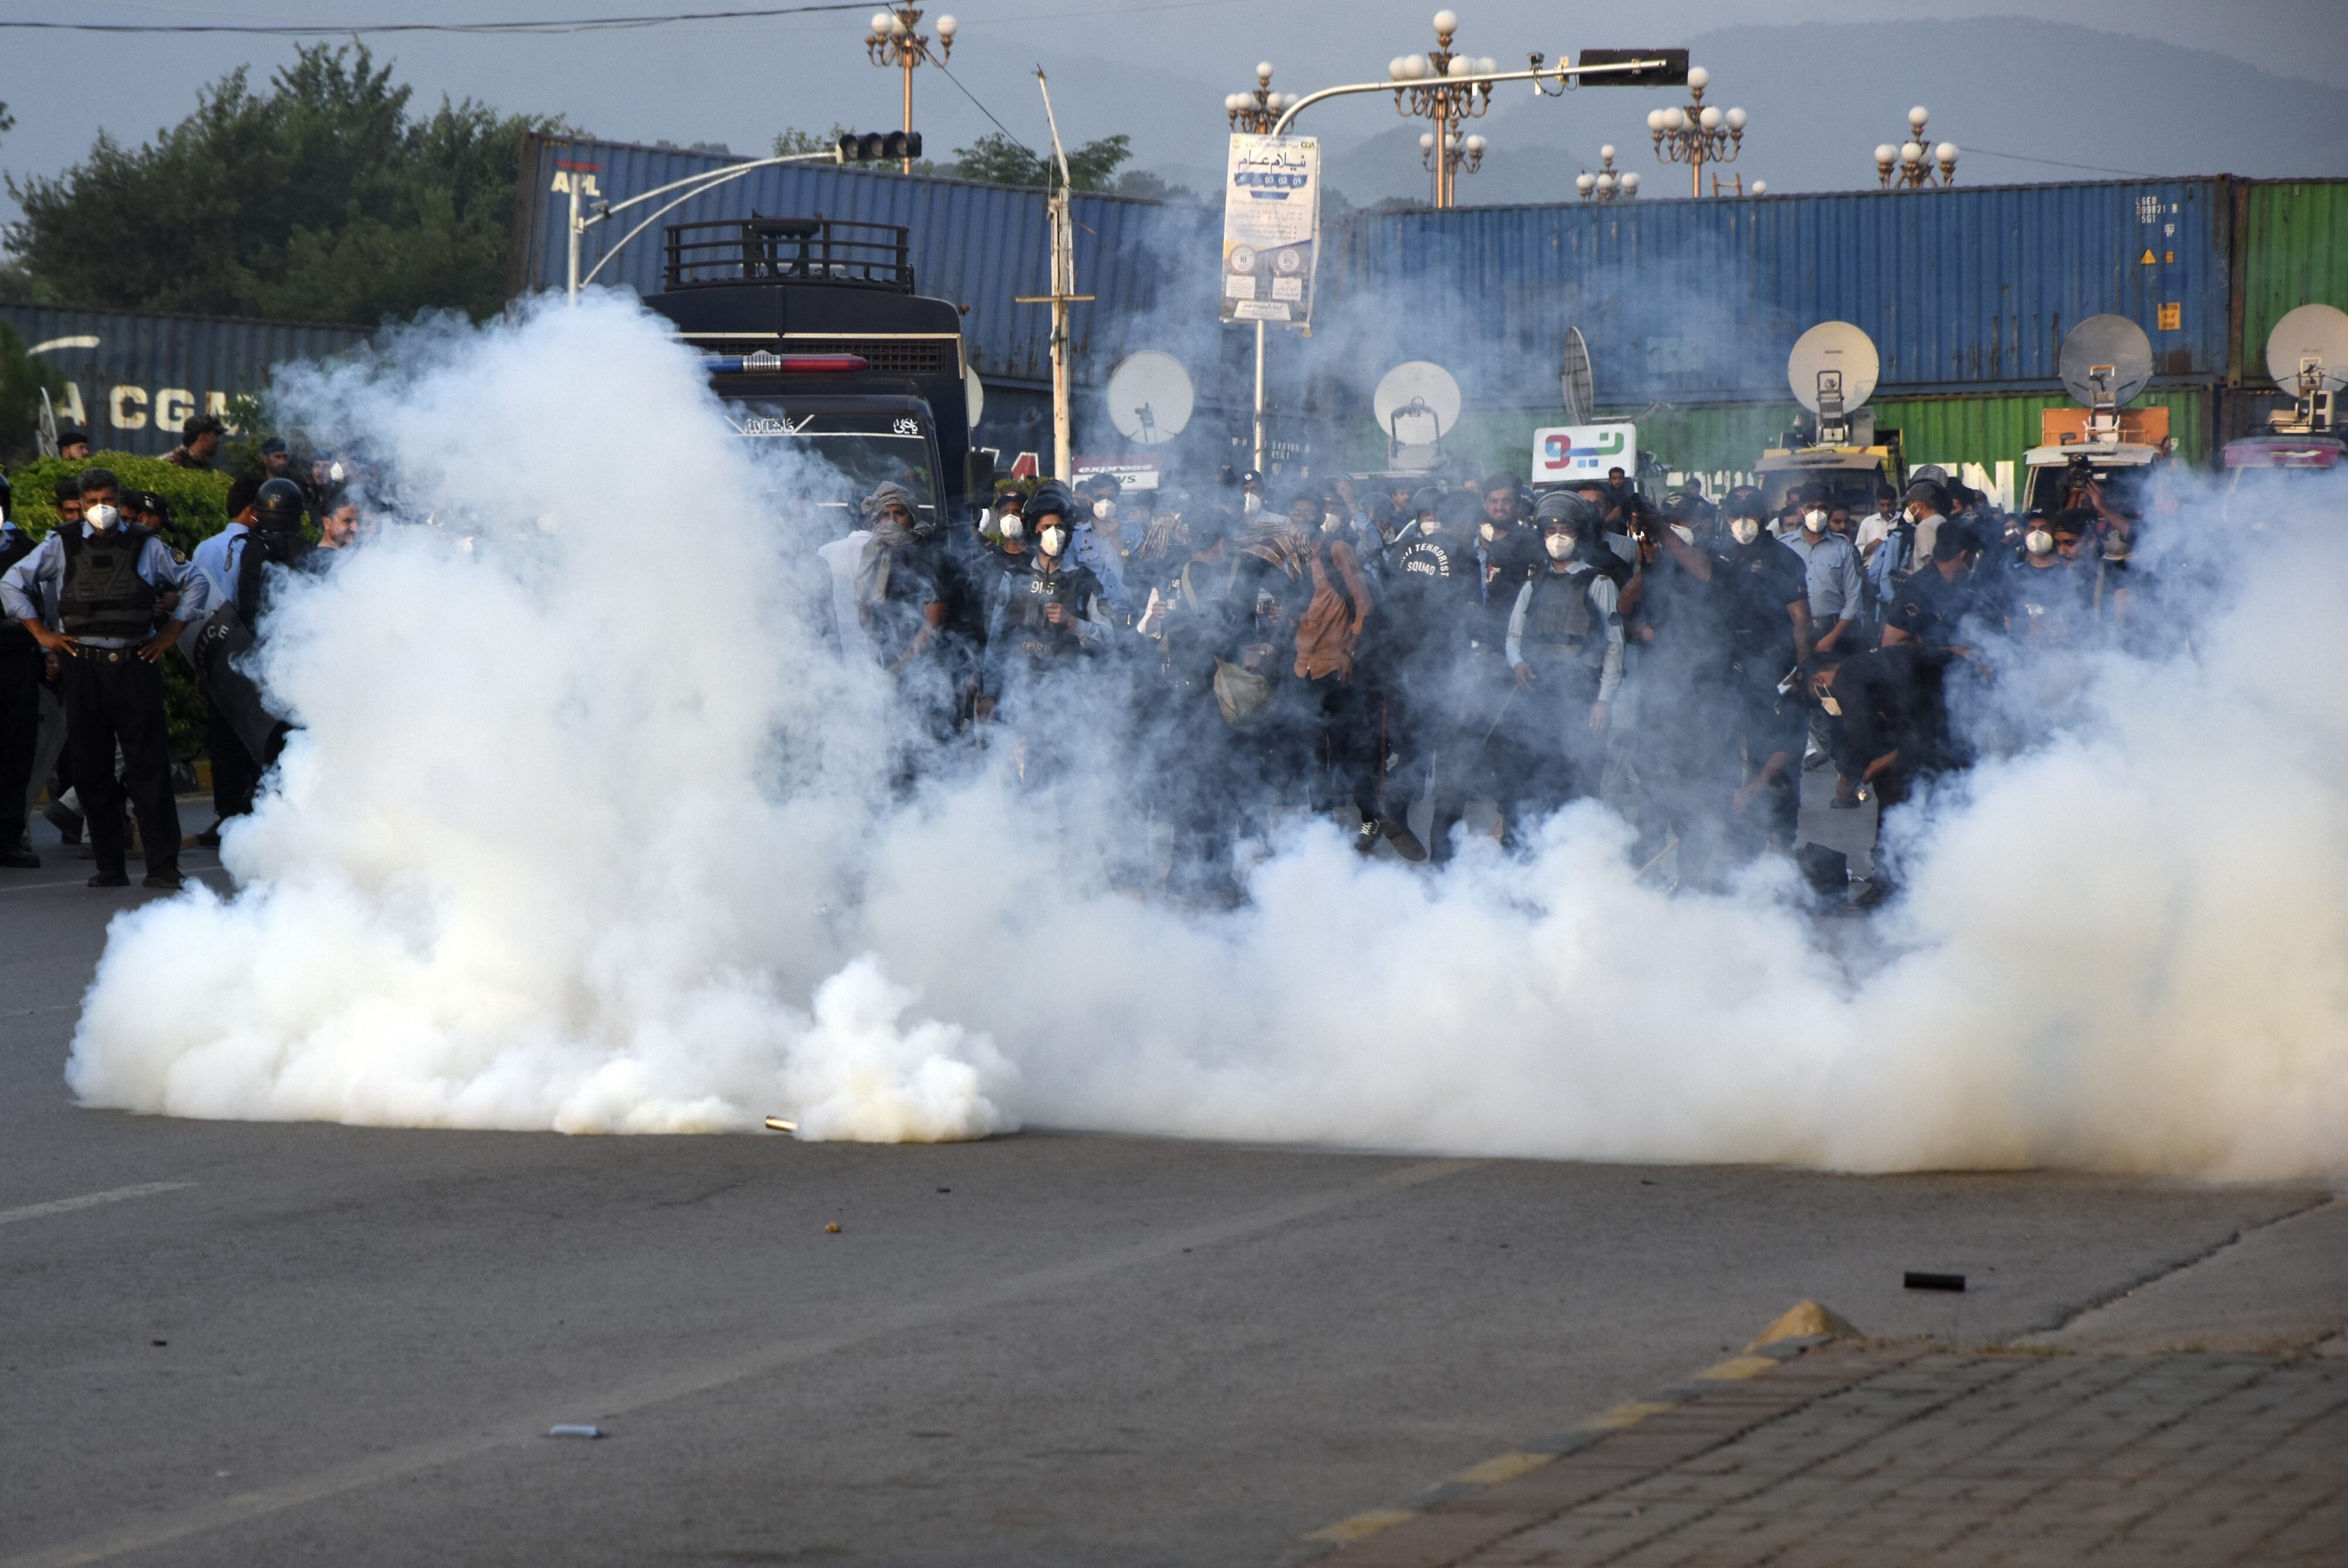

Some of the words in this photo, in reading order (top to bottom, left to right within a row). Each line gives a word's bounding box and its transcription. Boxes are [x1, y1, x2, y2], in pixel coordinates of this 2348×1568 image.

[1238, 149, 1270, 174] عام
[551, 171, 601, 197] AL
[1544, 432, 1625, 470] نیو
[1406, 561, 1436, 576] SQUAD
